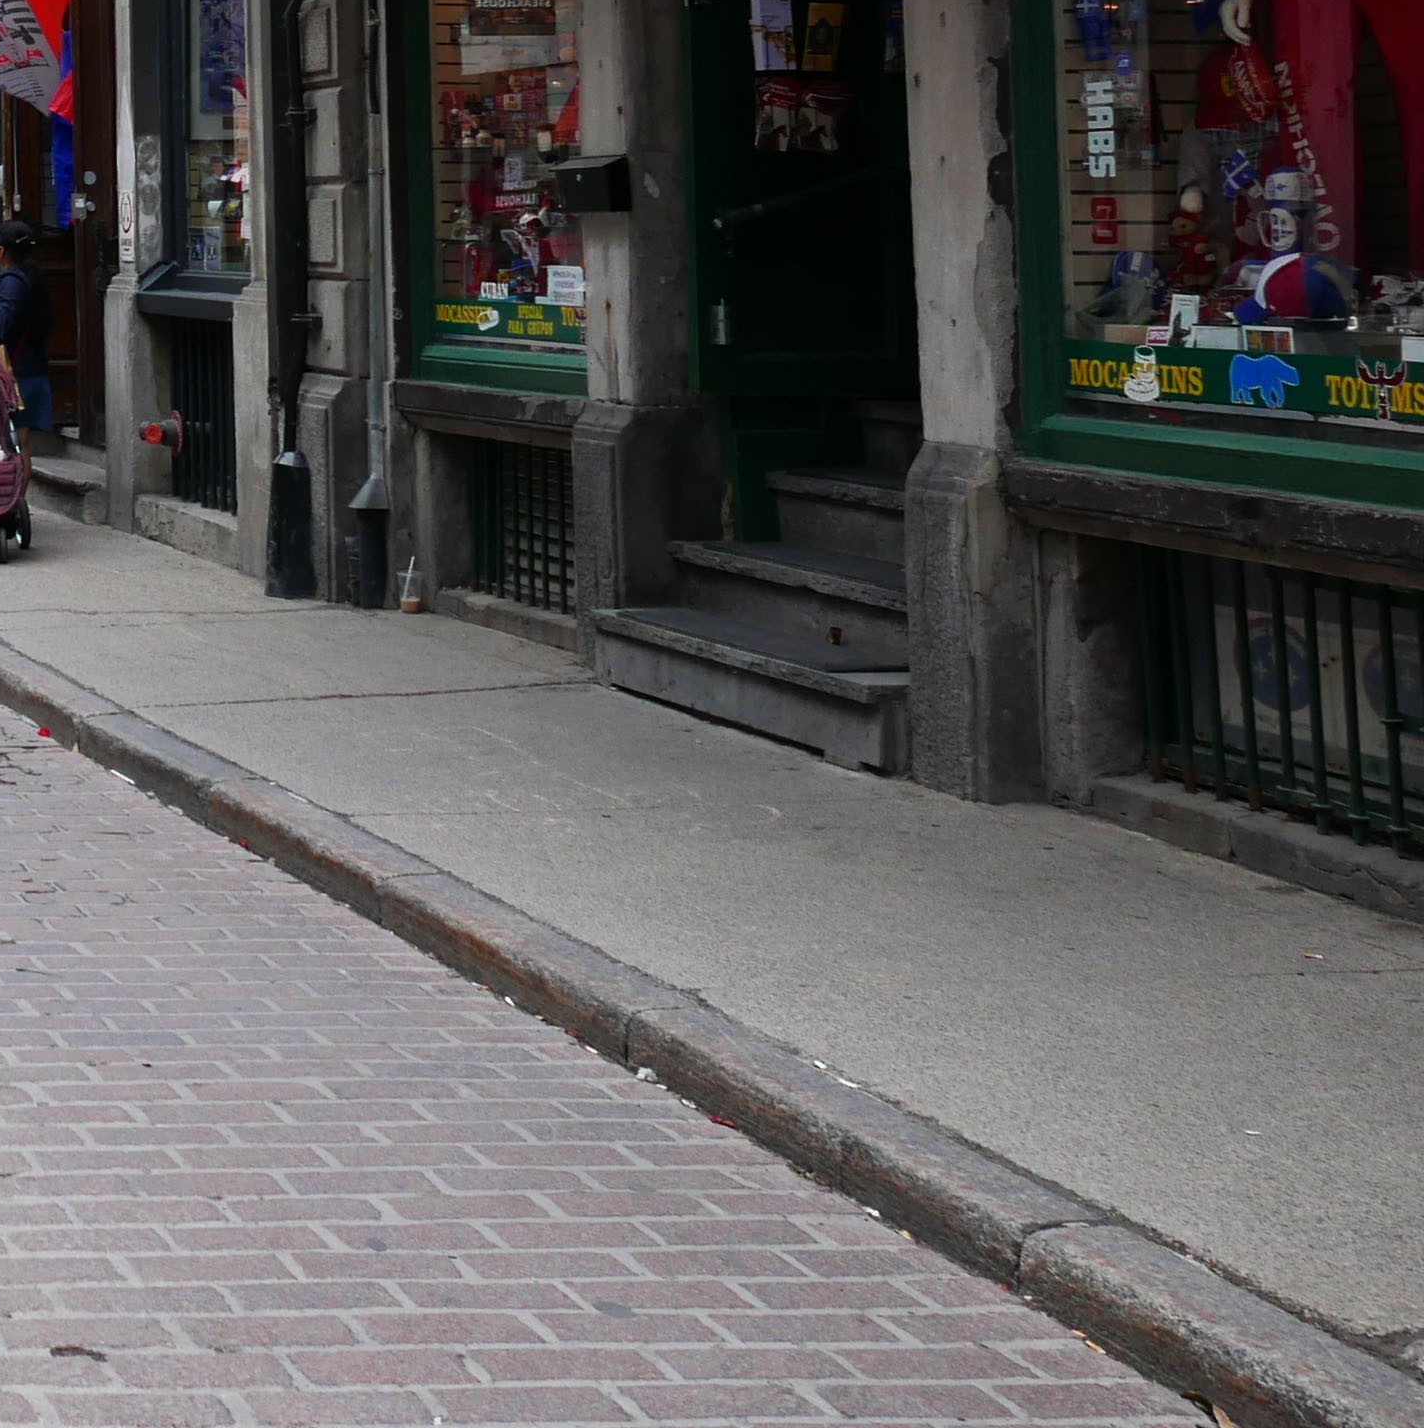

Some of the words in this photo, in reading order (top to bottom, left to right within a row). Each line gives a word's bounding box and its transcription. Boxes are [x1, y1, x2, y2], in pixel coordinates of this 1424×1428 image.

[1086, 80, 1117, 178] HABS
[436, 304, 494, 325] MOCASSI
[1068, 358, 1204, 397] MOCAINS
[1325, 374, 1424, 416] TOTMS
